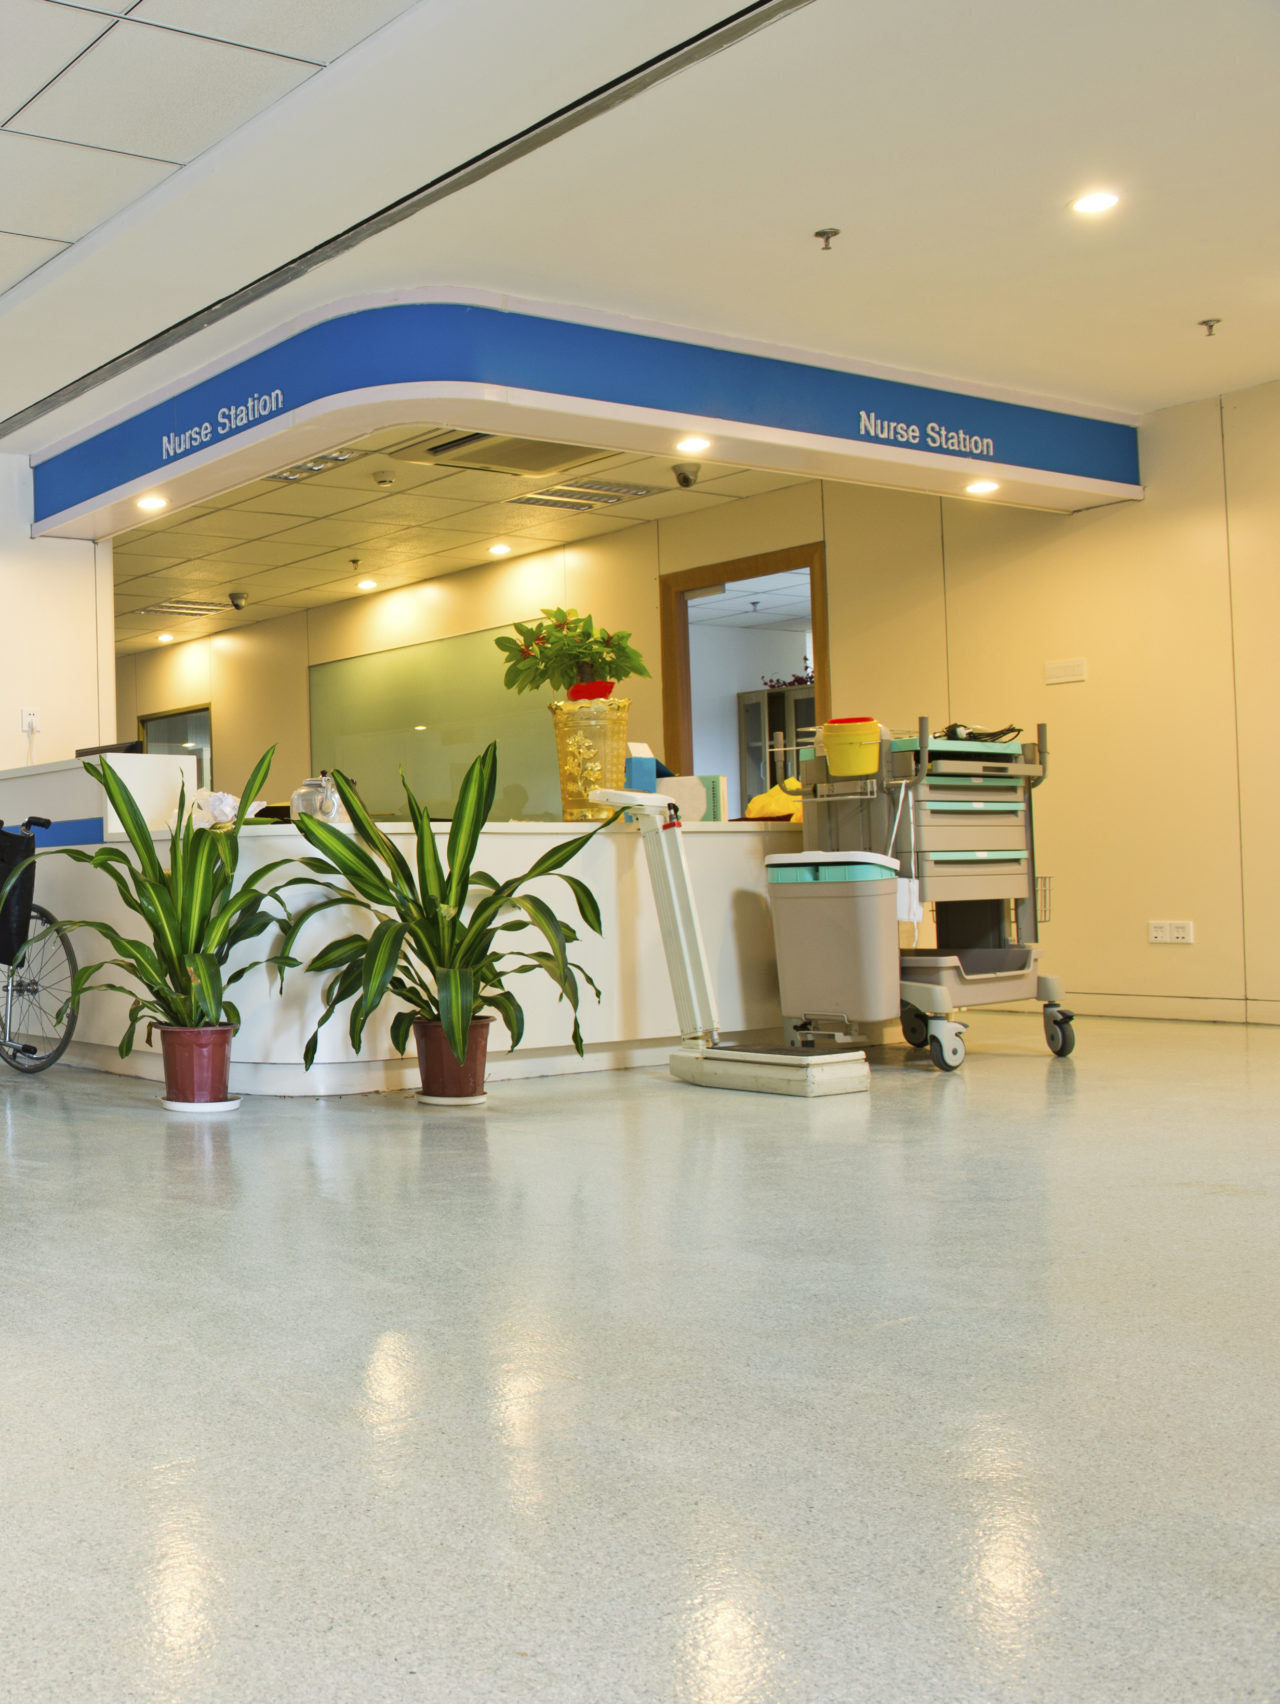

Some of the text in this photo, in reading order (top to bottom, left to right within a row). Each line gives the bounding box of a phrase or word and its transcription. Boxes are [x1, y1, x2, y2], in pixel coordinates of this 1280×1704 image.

[162, 388, 284, 459] Nurse Station
[859, 410, 994, 456] Nurse Station
